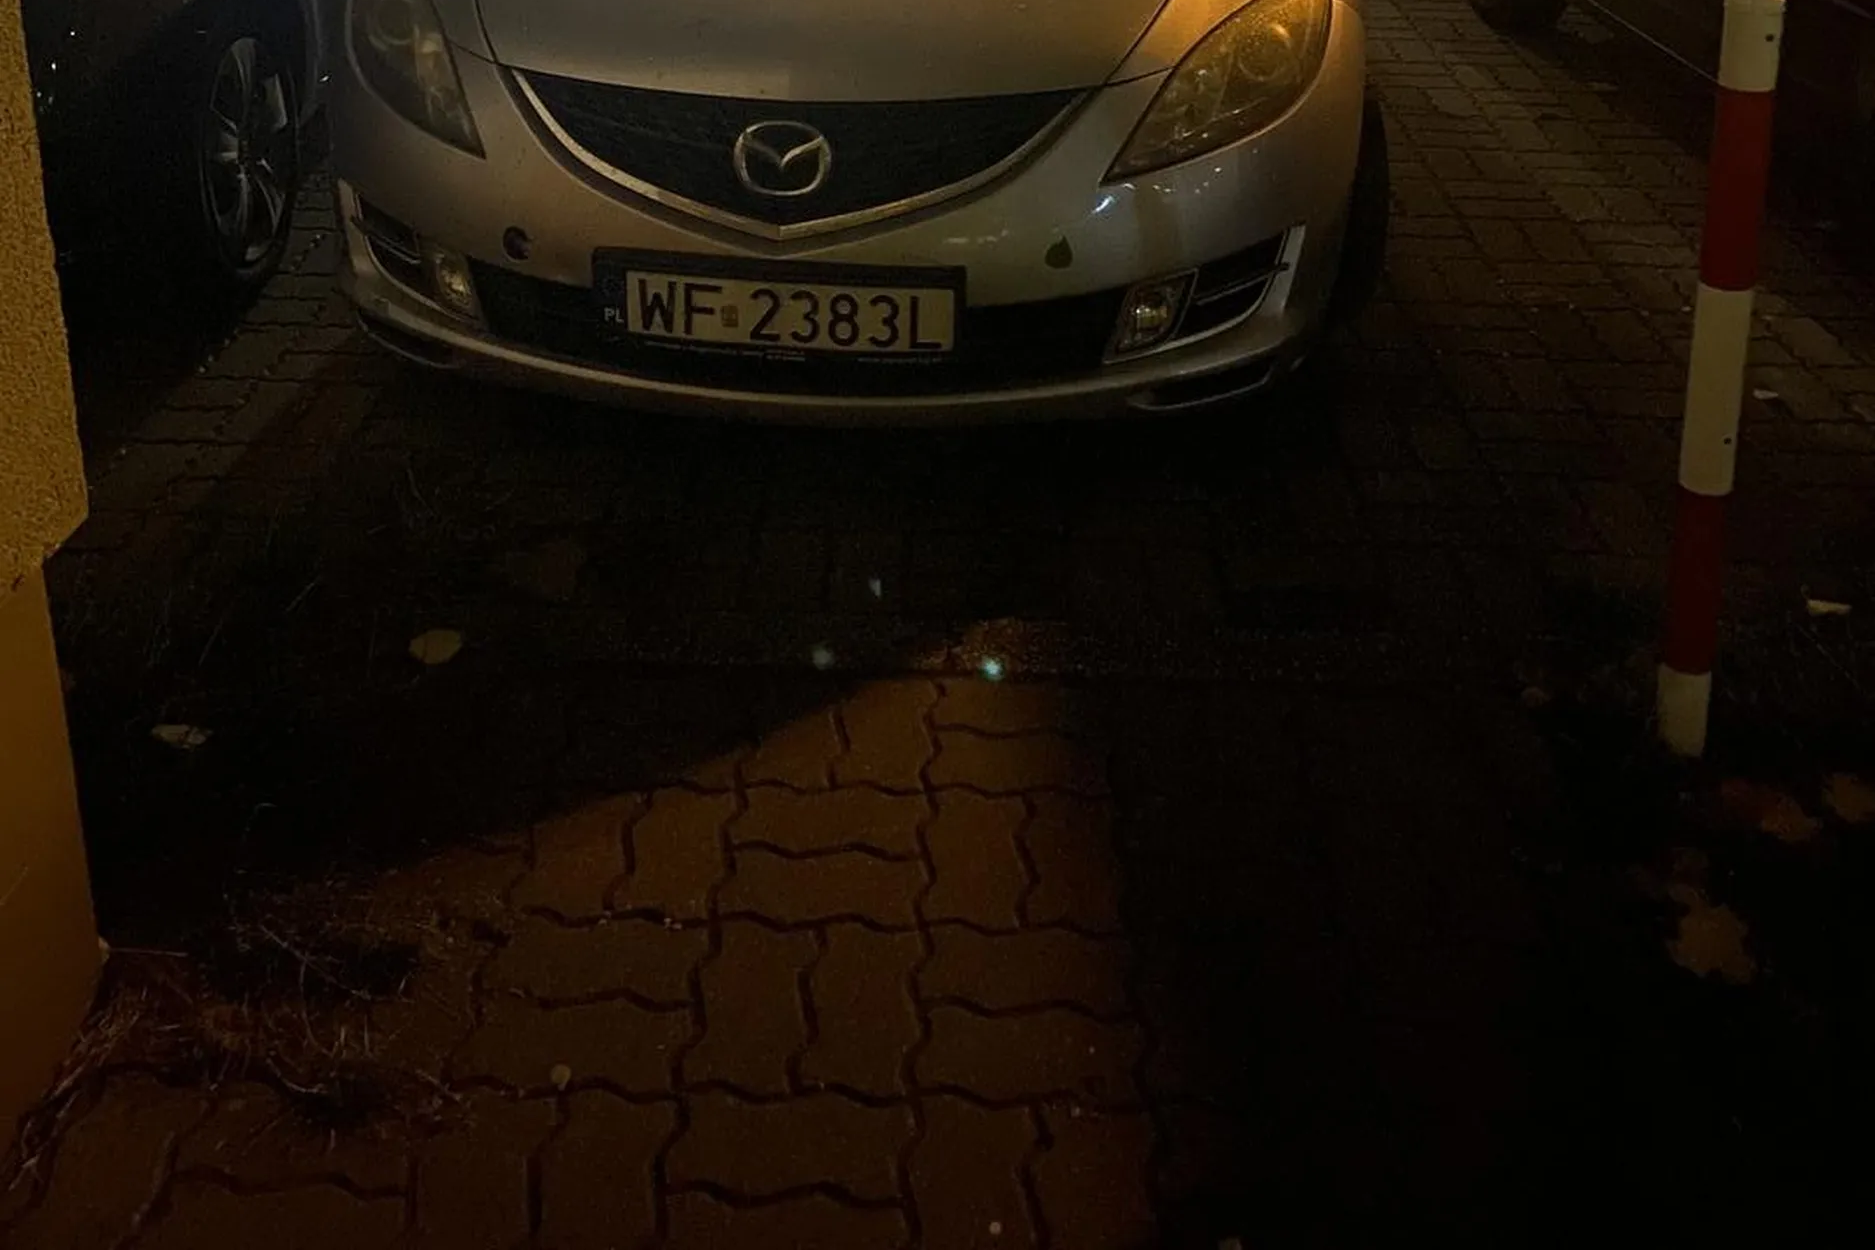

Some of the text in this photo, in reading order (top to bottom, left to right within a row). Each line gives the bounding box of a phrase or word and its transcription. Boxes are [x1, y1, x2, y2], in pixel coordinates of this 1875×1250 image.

[603, 306, 625, 324] PL
[636, 278, 943, 349] WF 2383L
